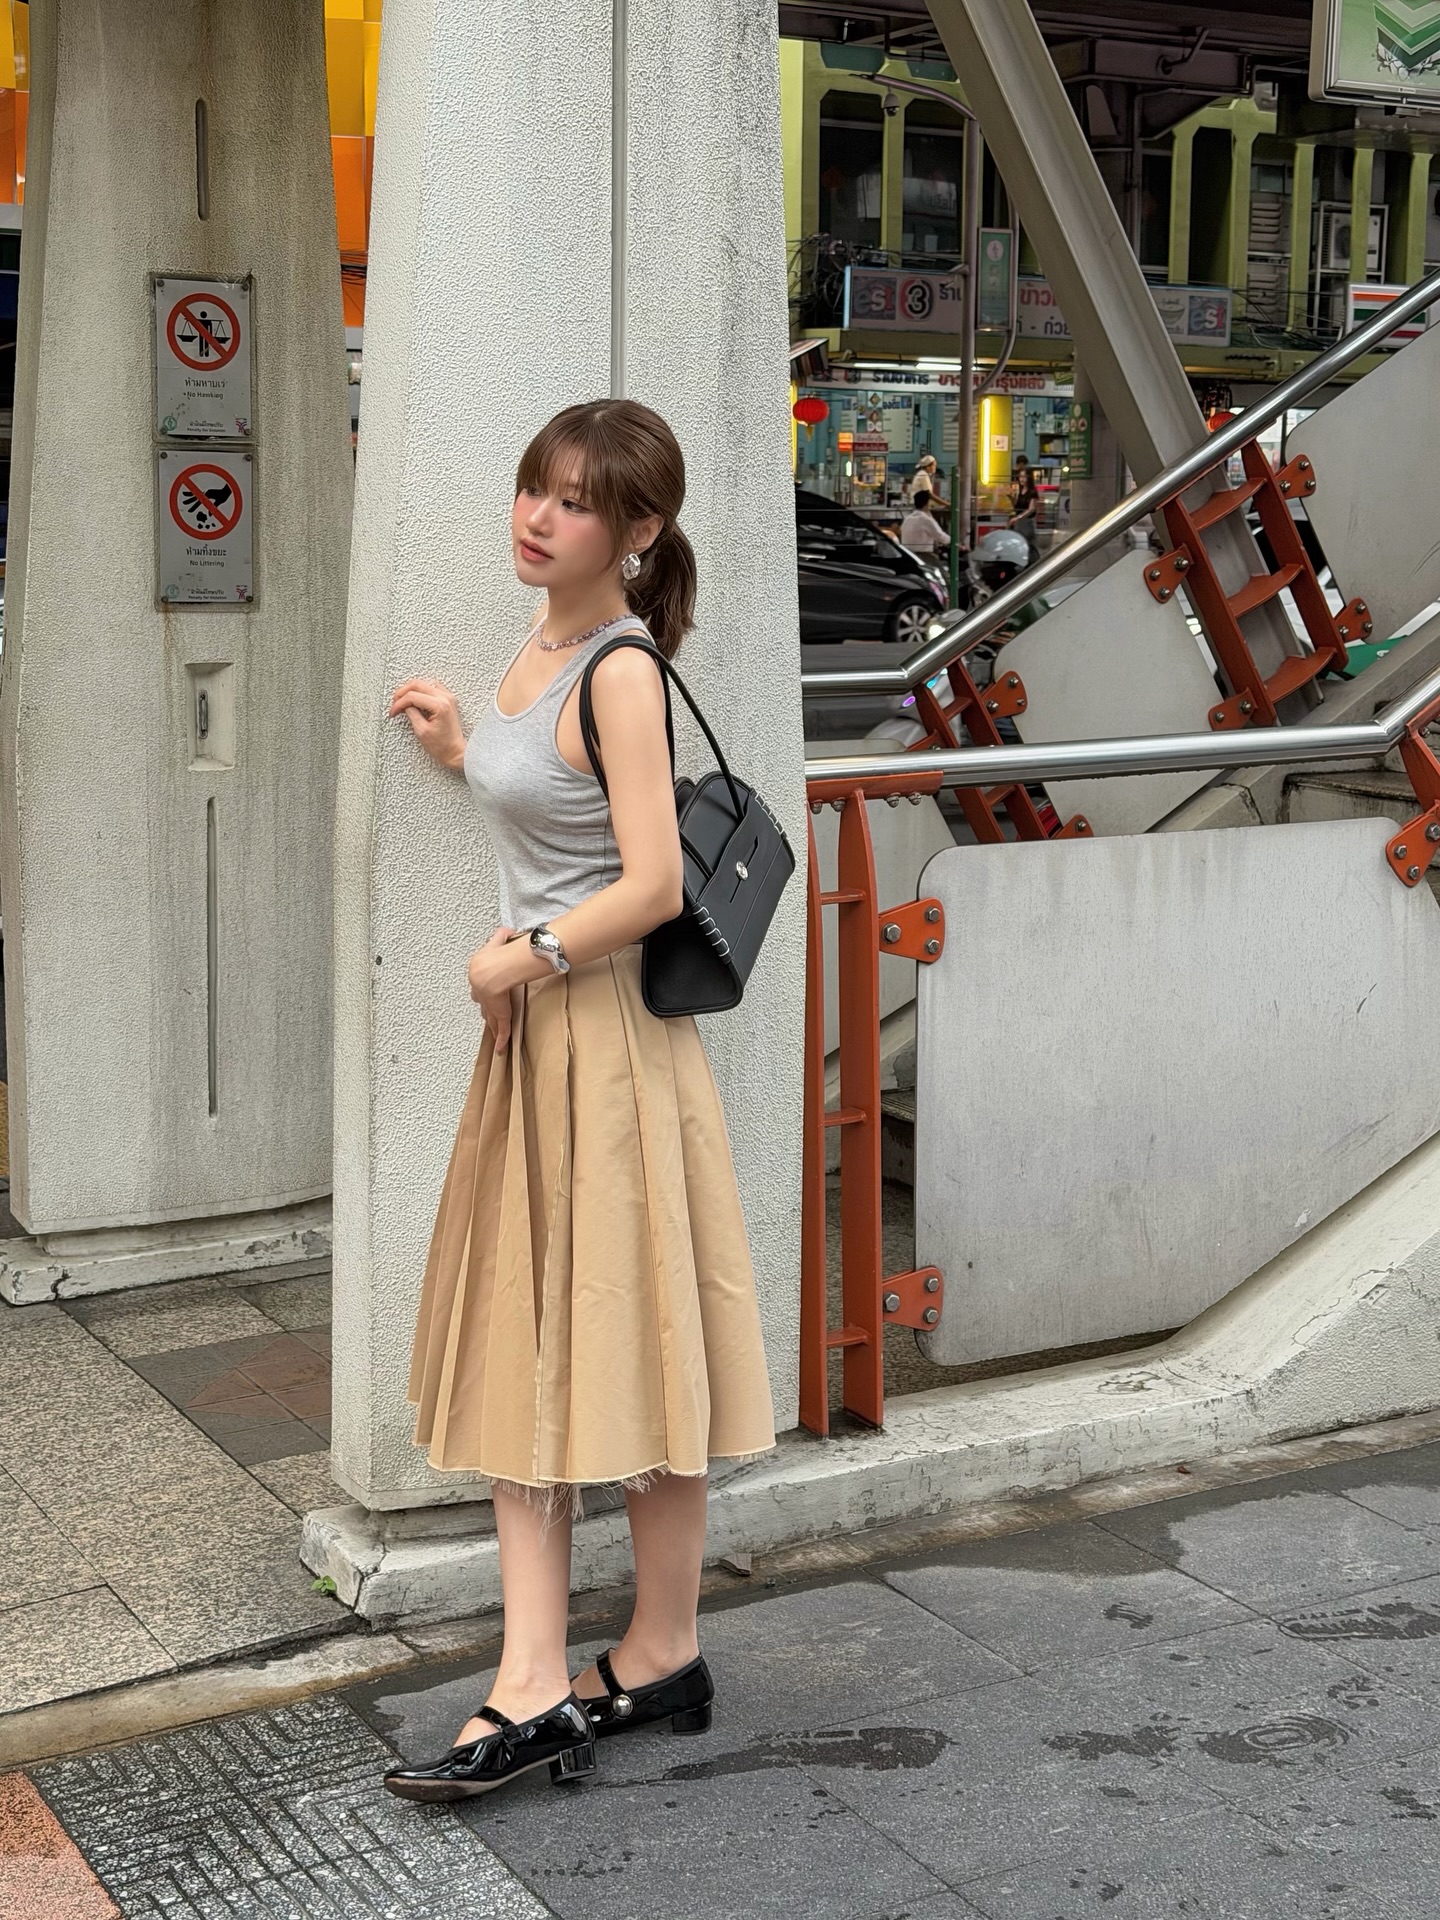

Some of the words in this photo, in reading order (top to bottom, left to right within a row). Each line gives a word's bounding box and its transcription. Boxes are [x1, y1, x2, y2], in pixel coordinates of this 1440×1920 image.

[186, 543, 227, 556] ห้ามทิ้งขยะ
